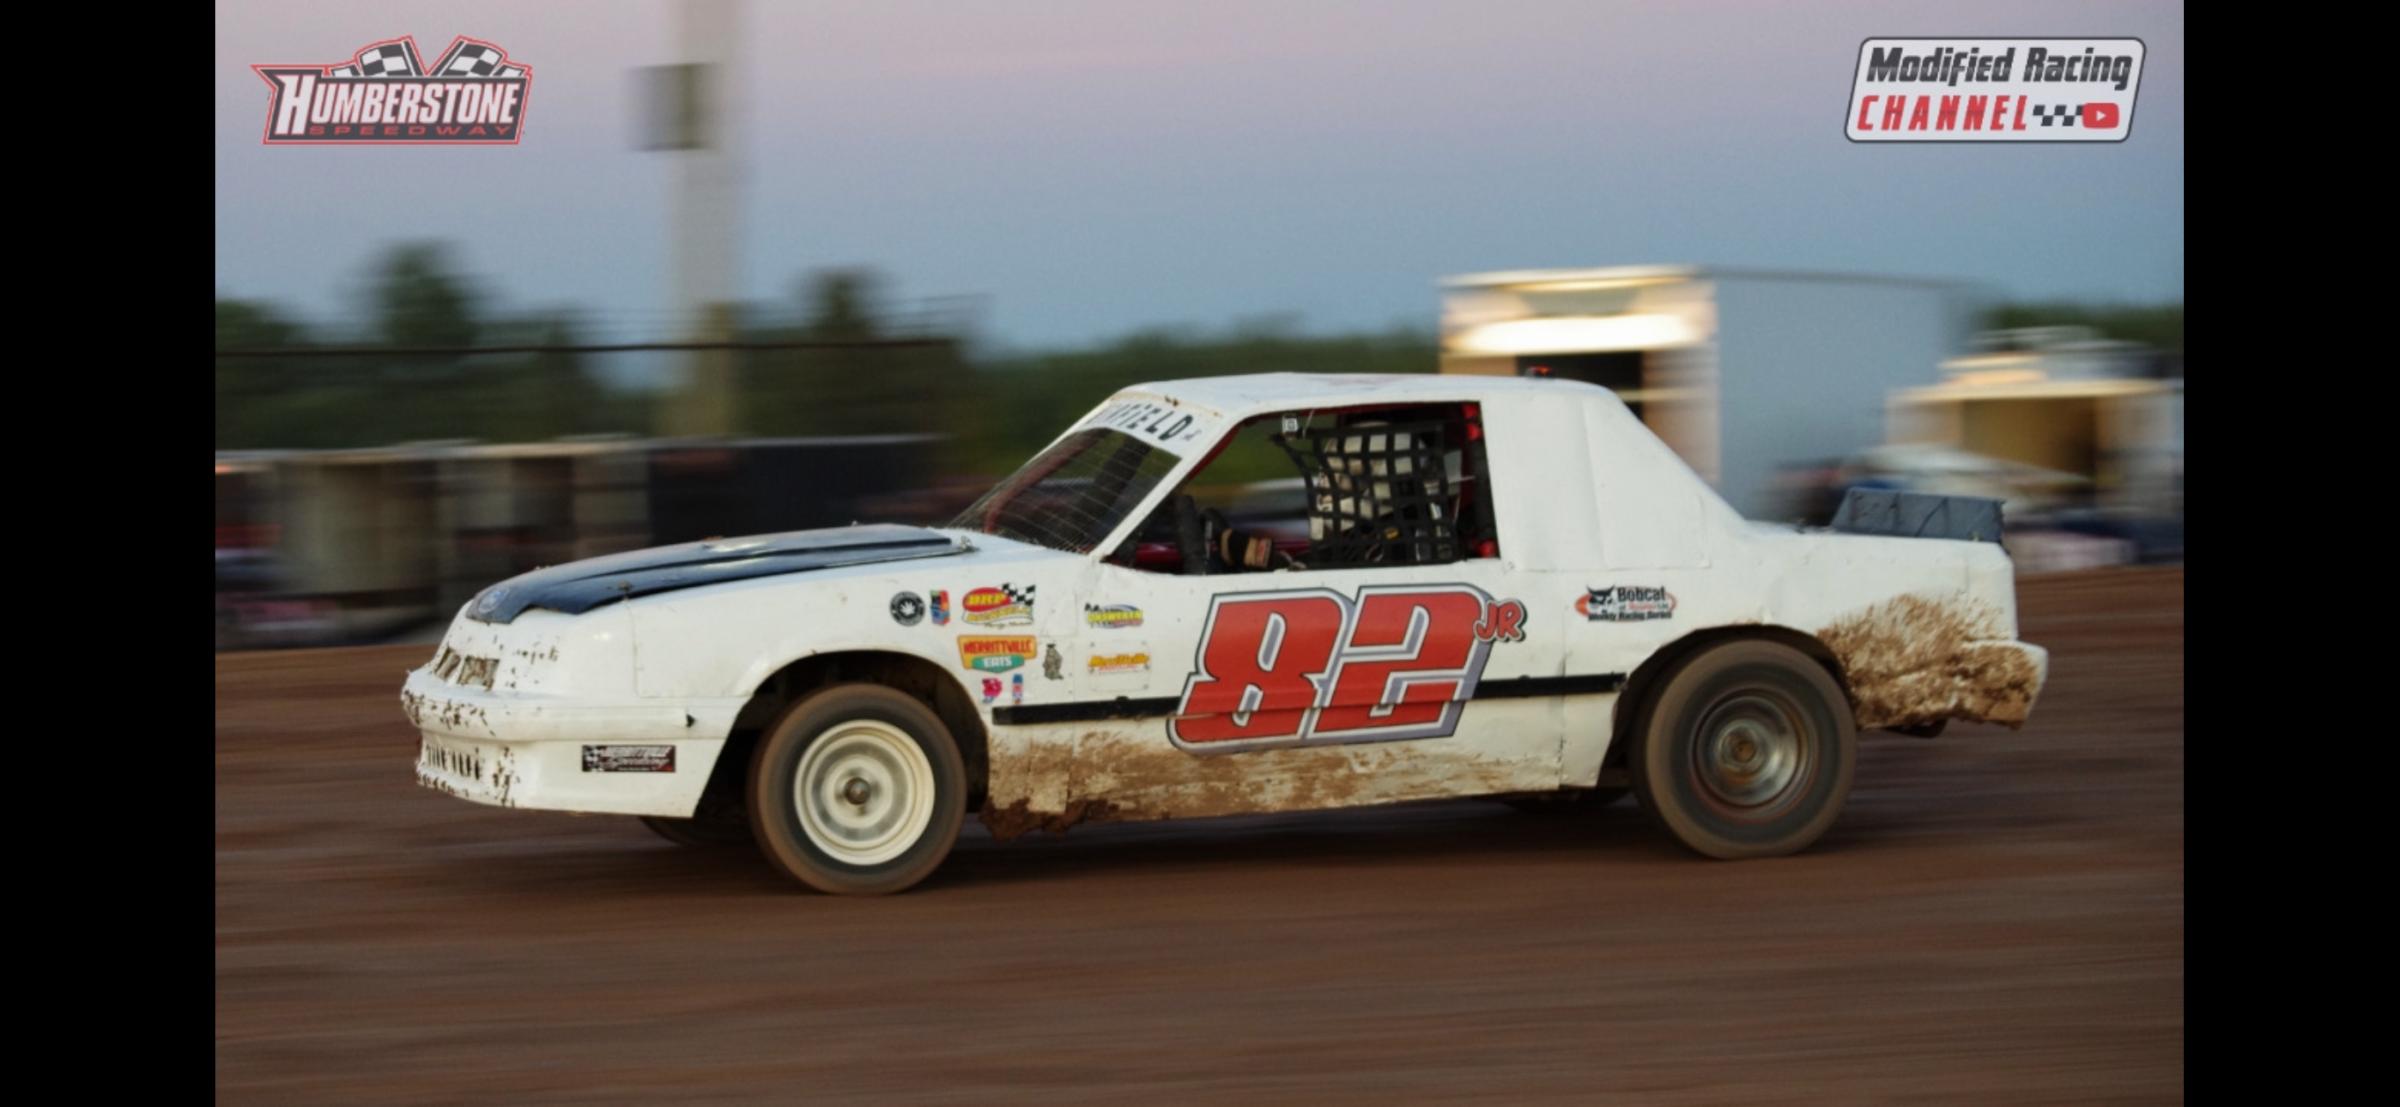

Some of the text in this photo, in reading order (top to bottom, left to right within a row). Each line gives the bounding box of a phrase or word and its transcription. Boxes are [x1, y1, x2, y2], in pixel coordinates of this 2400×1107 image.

[1617, 586, 1665, 602] Bobcat
[1166, 583, 1527, 756] 82 JR
